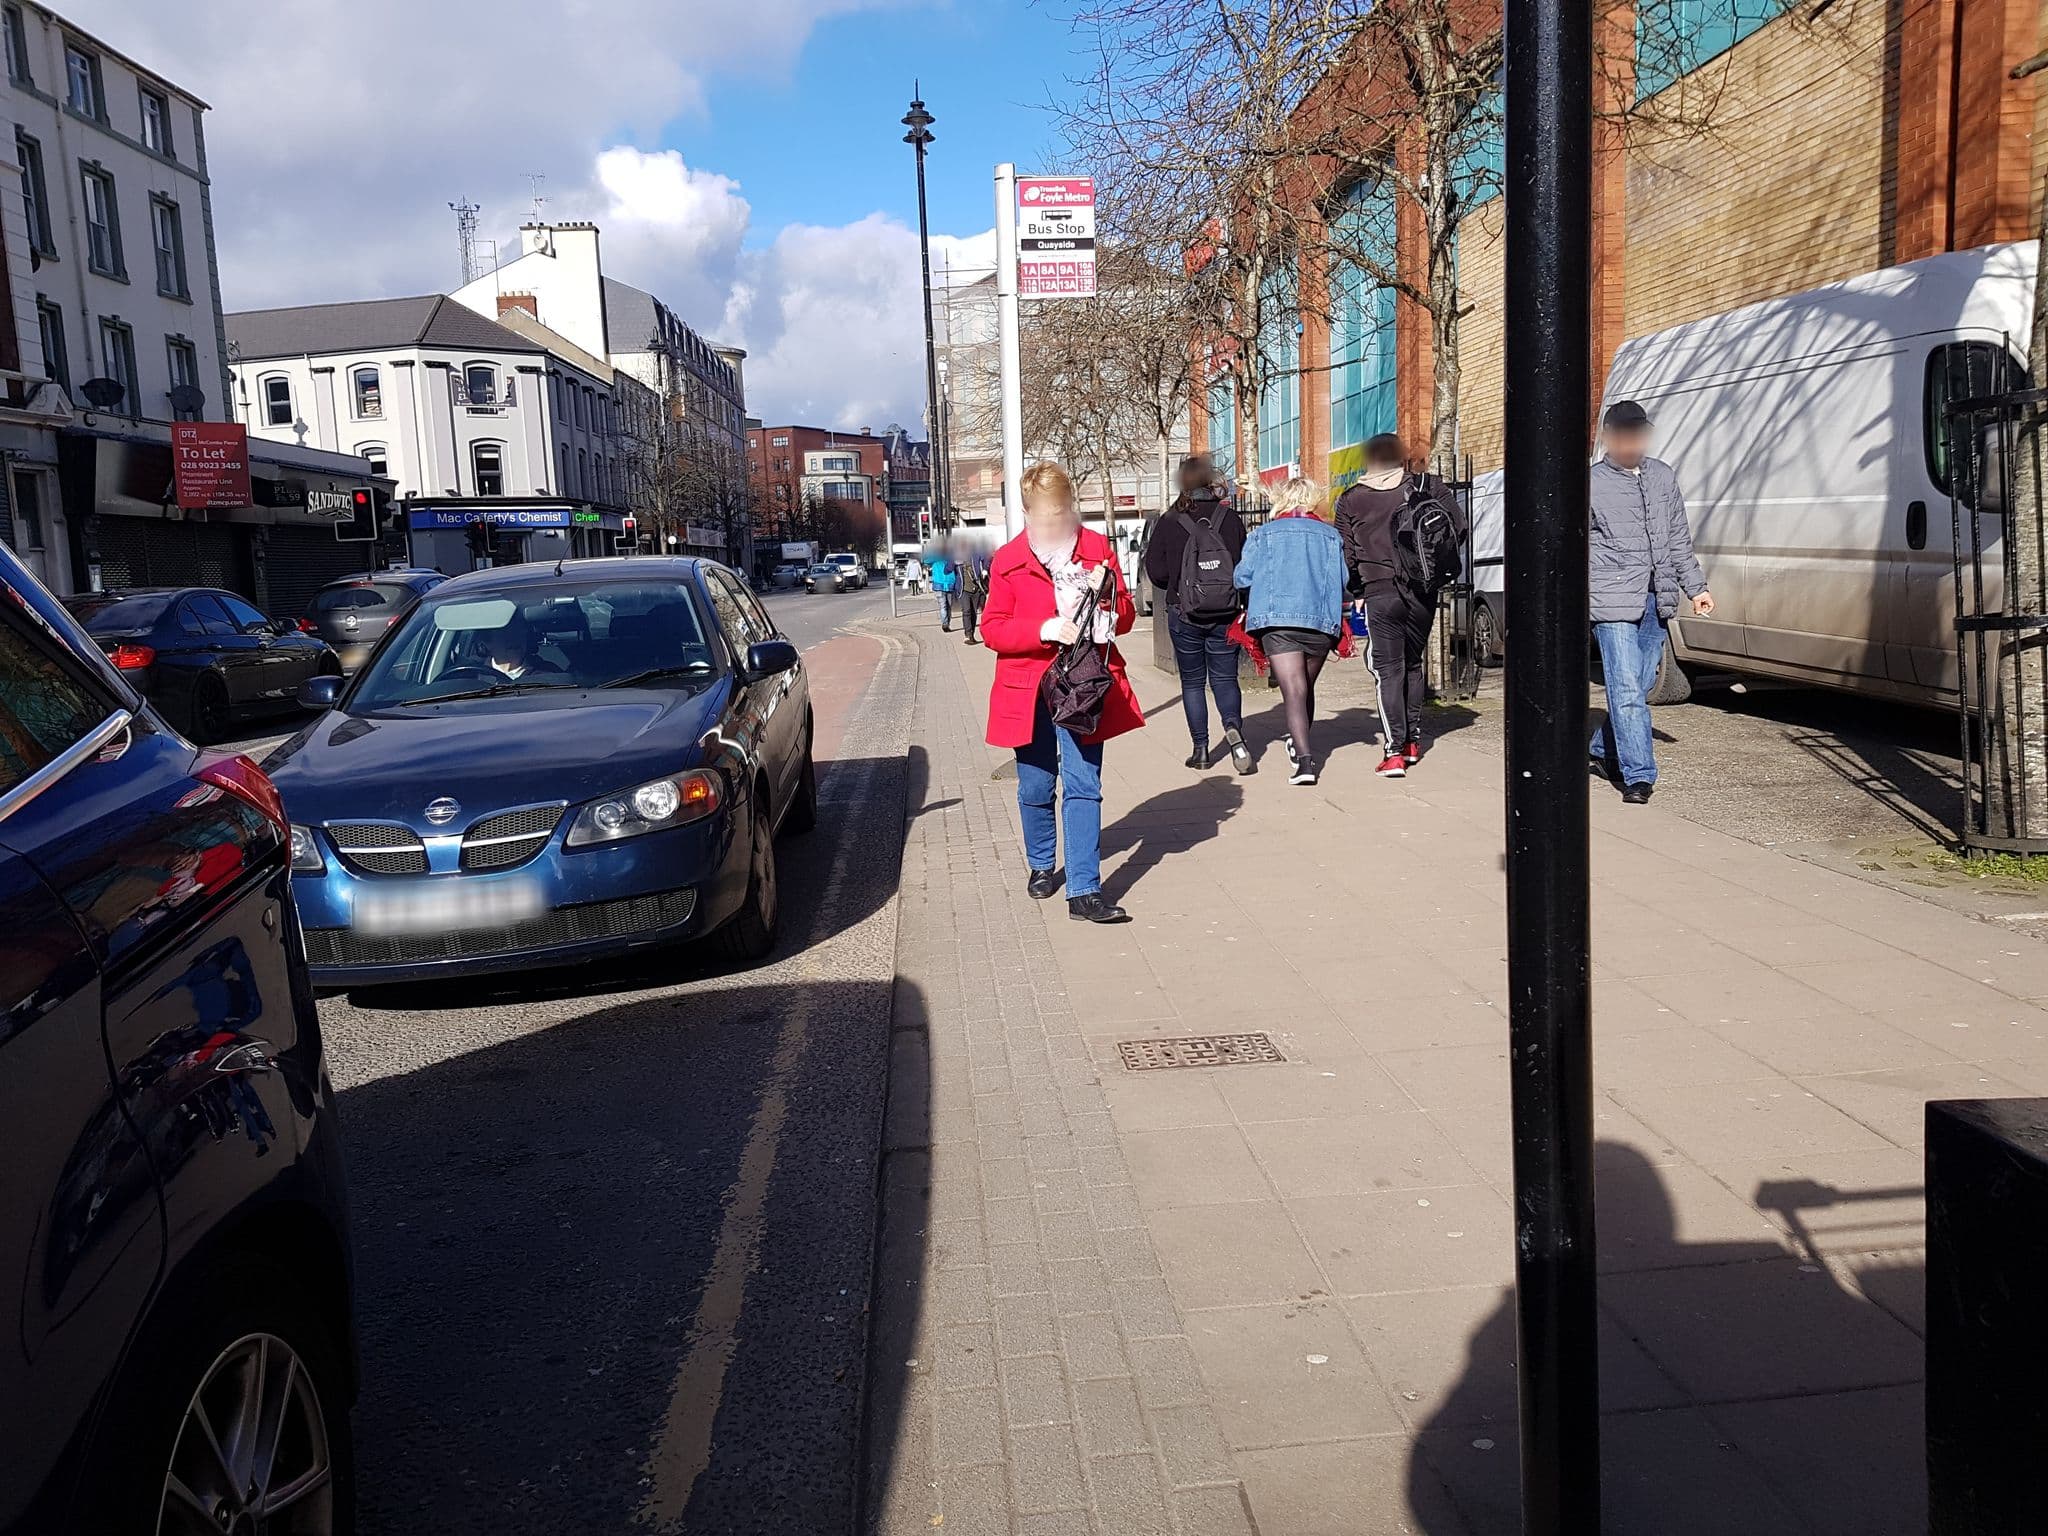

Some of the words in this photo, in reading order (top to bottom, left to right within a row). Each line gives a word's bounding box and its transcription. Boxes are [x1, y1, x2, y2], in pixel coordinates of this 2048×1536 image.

[1040, 193, 1063, 204] Foyle
[1065, 192, 1091, 202] Metro
[1028, 223, 1052, 234] Bus
[1056, 223, 1085, 235] Stop
[1037, 240, 1076, 250] Quayside
[1023, 265, 1037, 275] 1A
[1041, 265, 1056, 275] 8A
[1059, 265, 1074, 275] 9A
[1041, 281, 1057, 290] 12A
[1059, 280, 1076, 290] 13A
[181, 430, 197, 439] DTZ
[180, 447, 199, 459] To
[203, 447, 226, 459] Let
[307, 490, 353, 513] SANDWIC
[436, 512, 462, 523] Mac
[518, 511, 562, 523] Chemist
